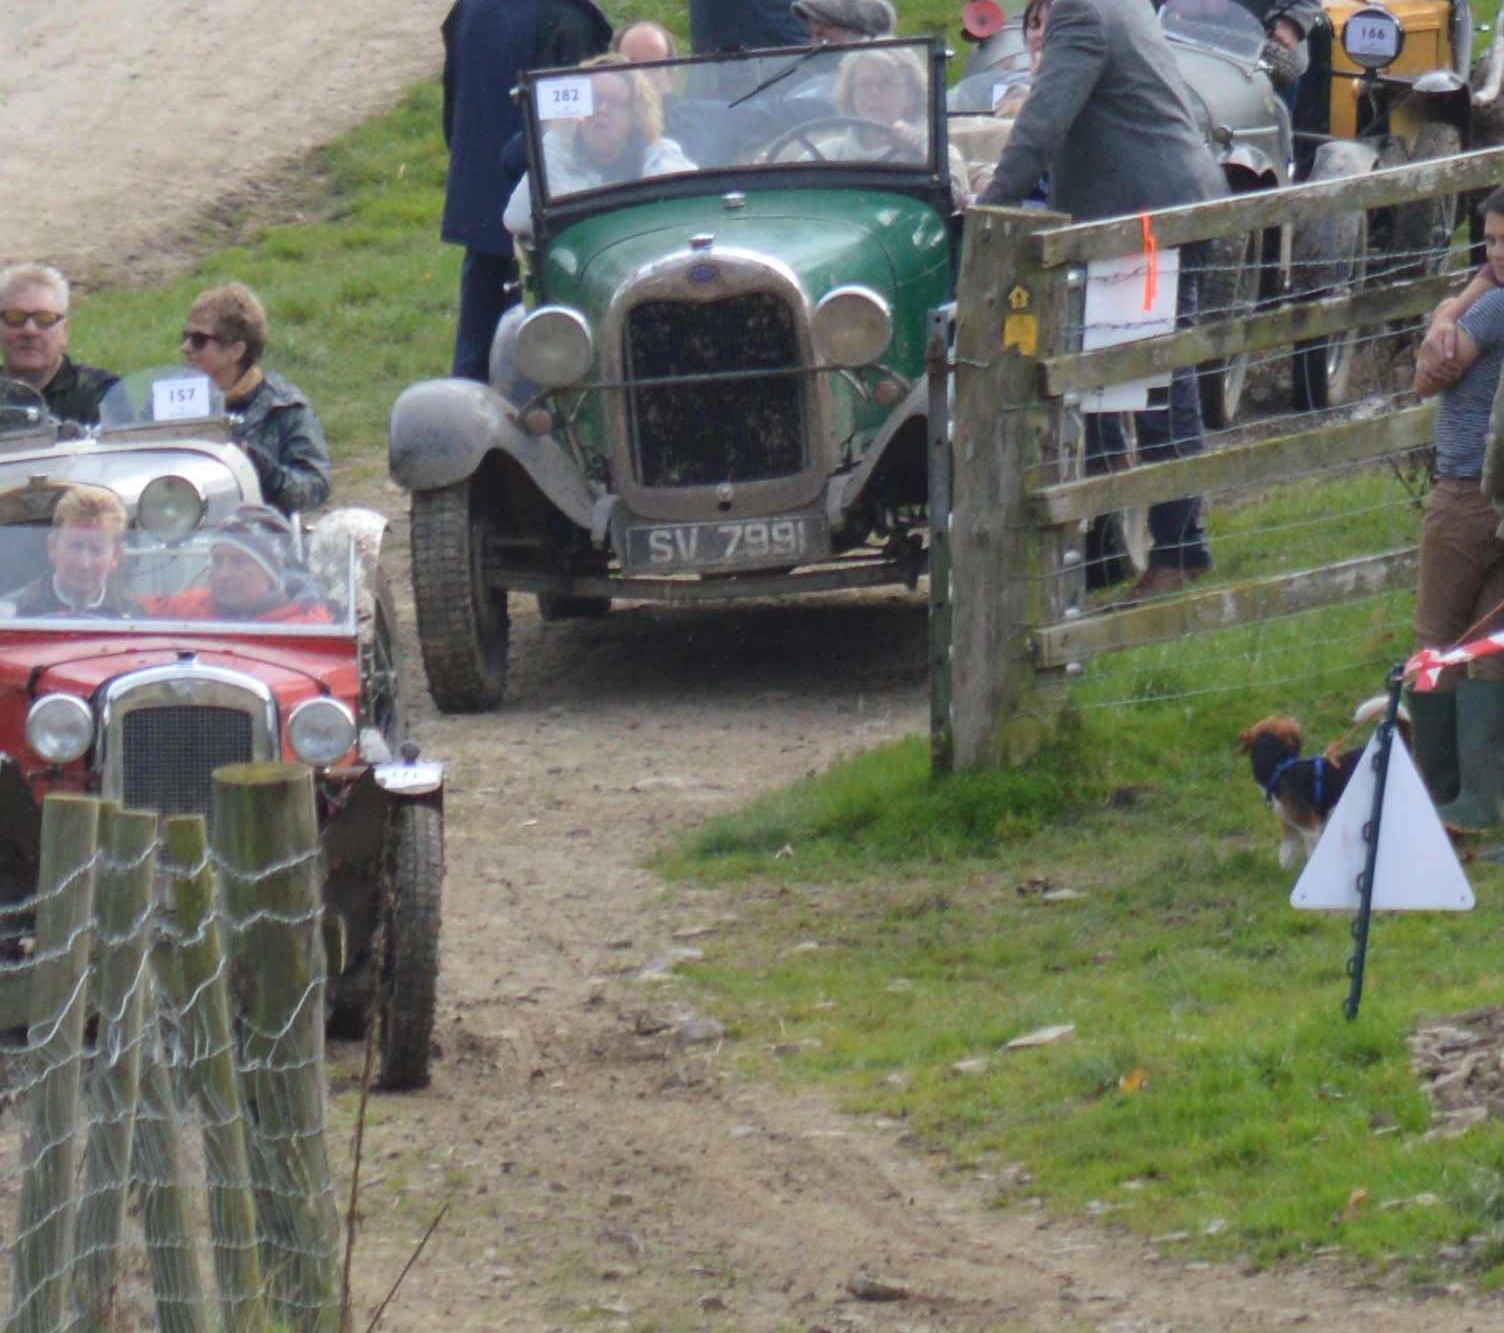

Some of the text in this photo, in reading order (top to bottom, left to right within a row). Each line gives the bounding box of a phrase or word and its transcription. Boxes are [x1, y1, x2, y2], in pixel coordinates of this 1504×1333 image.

[1361, 26, 1386, 40] 166
[552, 89, 579, 103] 282
[169, 387, 196, 403] 157
[648, 520, 807, 563] SV 7991
